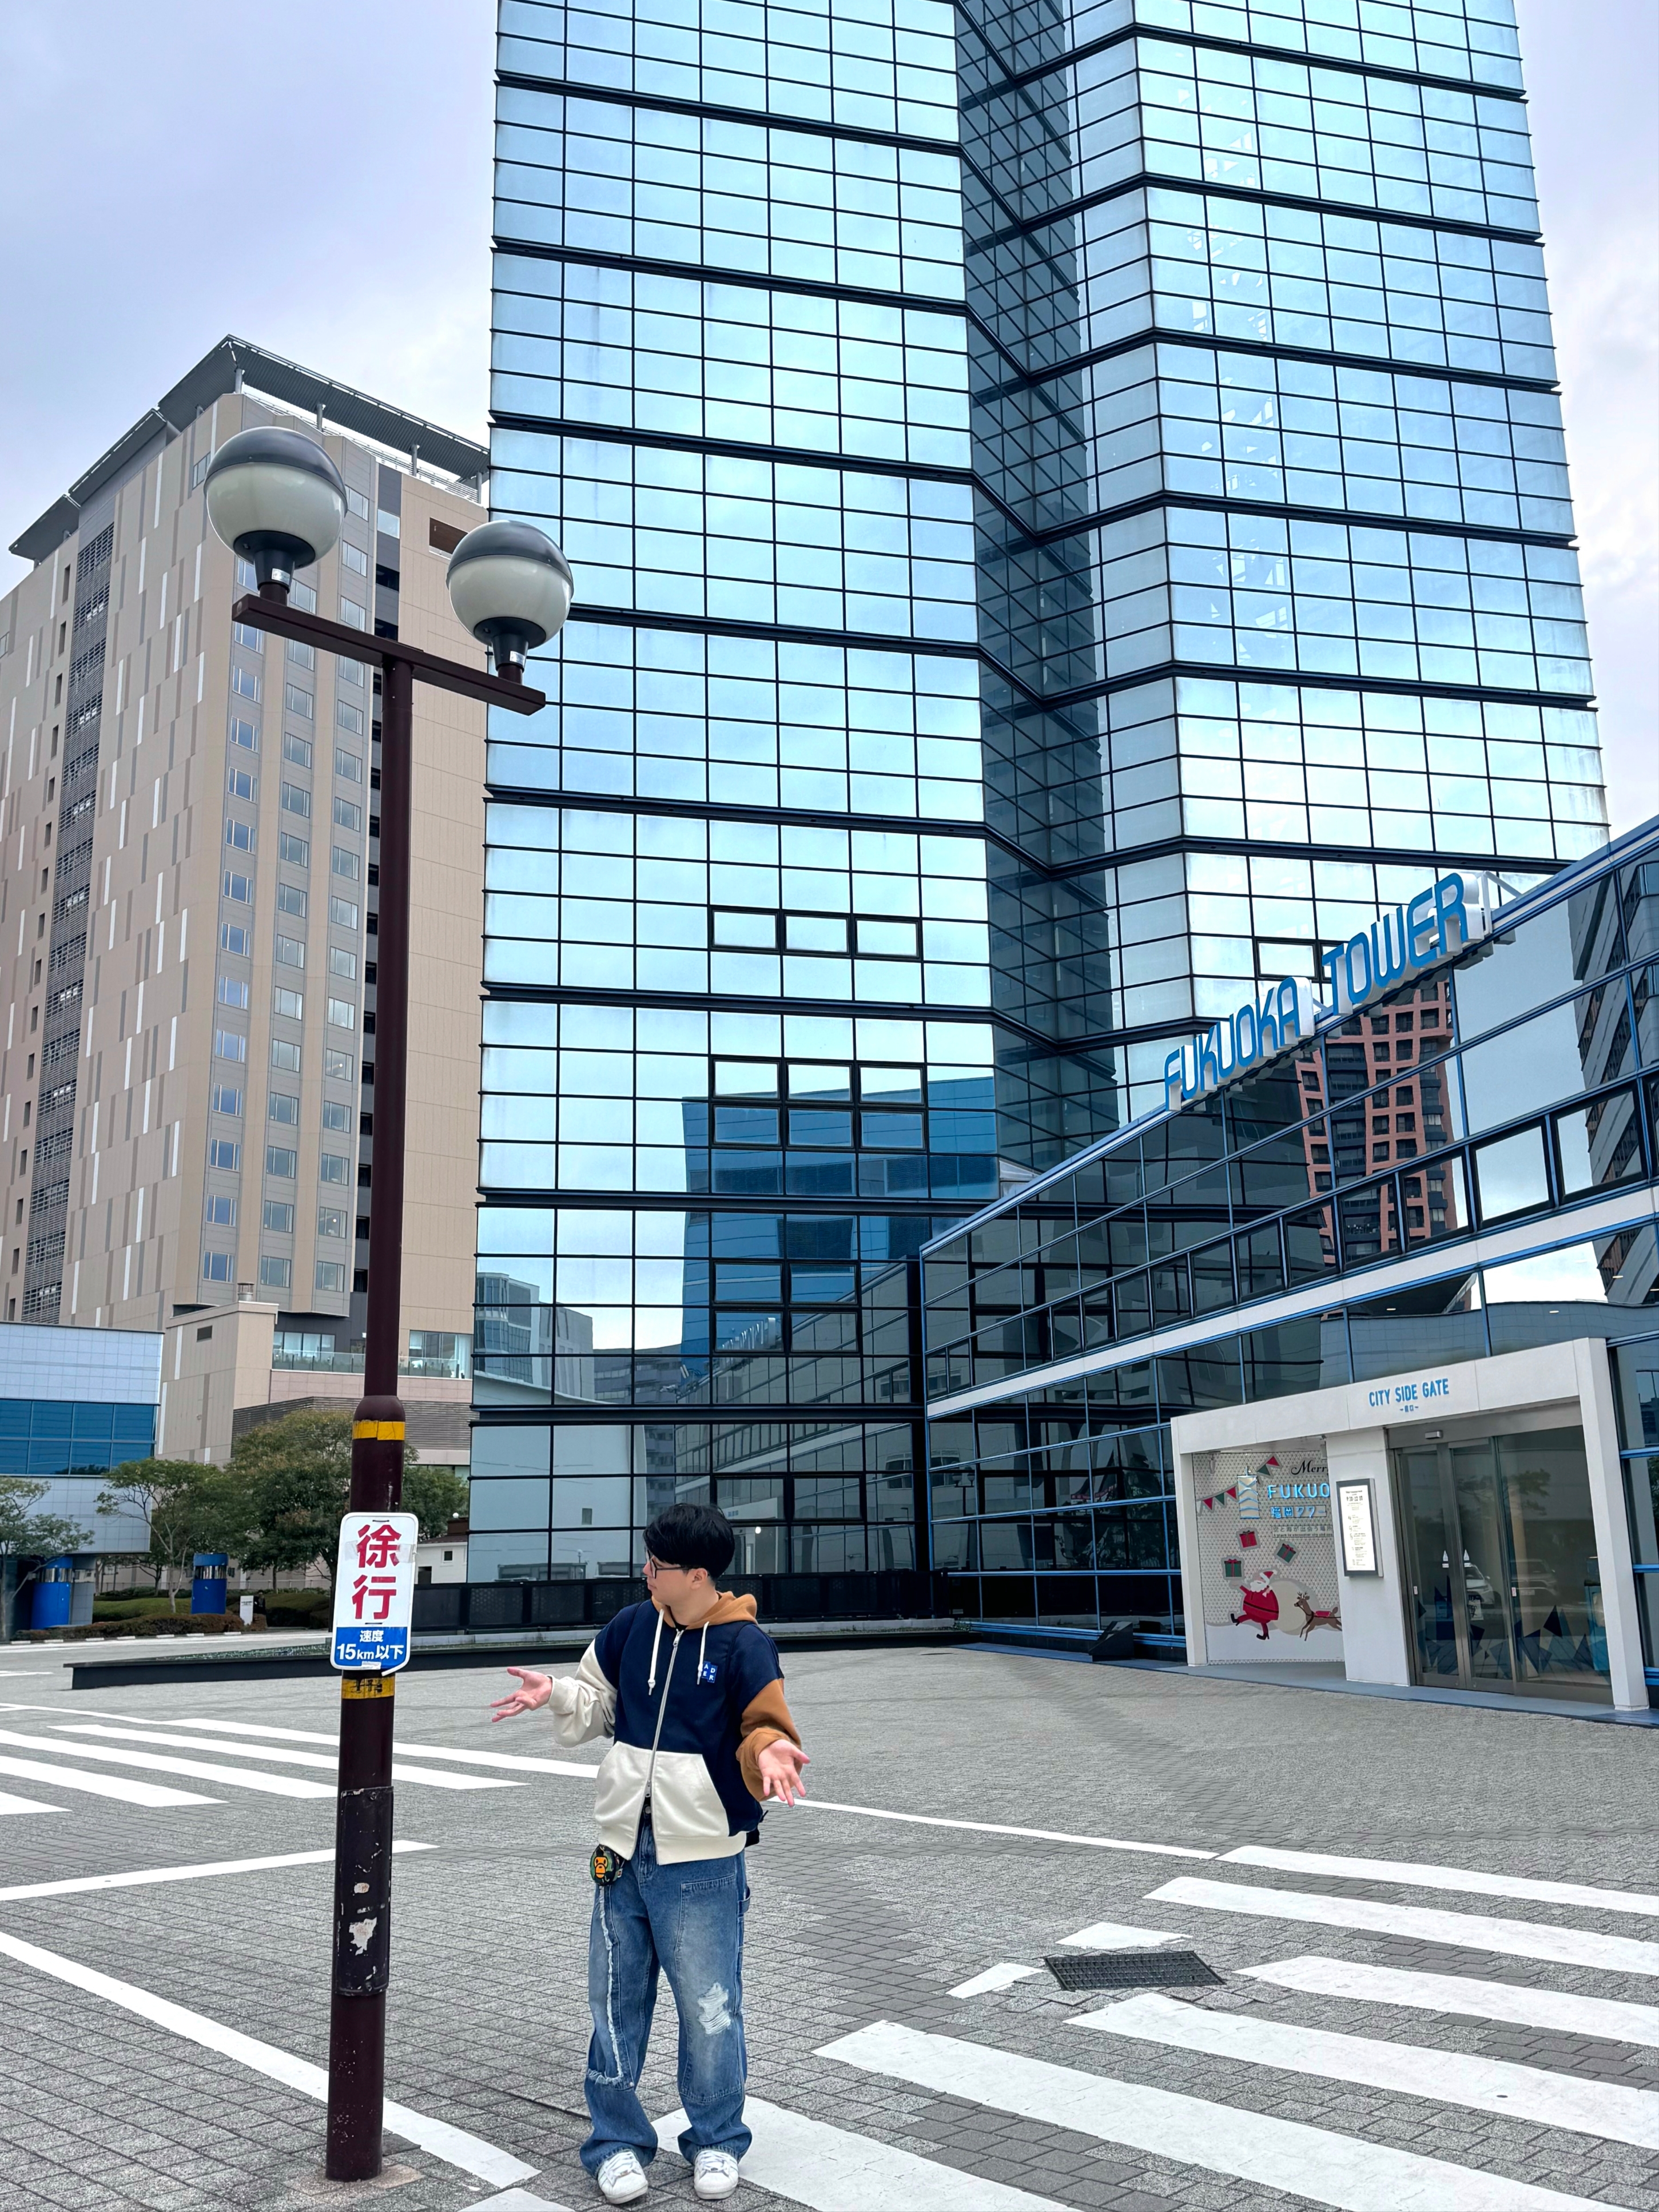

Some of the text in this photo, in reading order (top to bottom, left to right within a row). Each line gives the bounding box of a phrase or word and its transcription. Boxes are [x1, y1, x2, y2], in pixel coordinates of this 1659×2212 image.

[1164, 873, 1475, 1112] FUKUOKA TOWER
[1368, 1378, 1450, 1407] CITY SIDE GATE
[1291, 1459, 1329, 1475] Merr
[351, 1524, 402, 1620] 徐行
[359, 1630, 384, 1643] 速度
[336, 1643, 404, 1661] 15km以下
